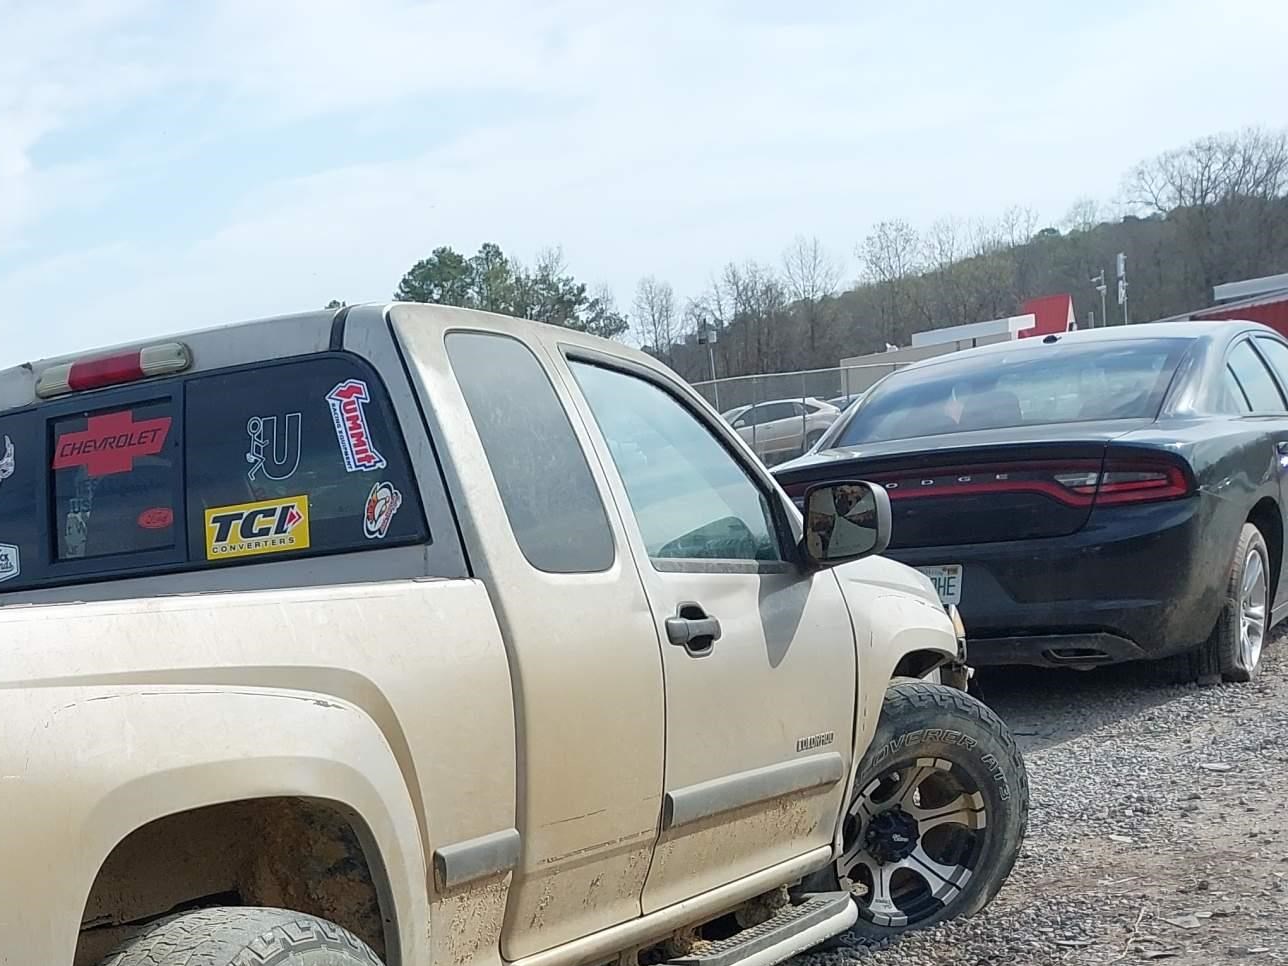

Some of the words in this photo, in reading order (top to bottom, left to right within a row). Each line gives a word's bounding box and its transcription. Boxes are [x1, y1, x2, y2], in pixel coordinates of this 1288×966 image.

[60, 428, 162, 458] CHEVROLET
[212, 504, 297, 543] TCI
[212, 537, 295, 554] CONVERTERS
